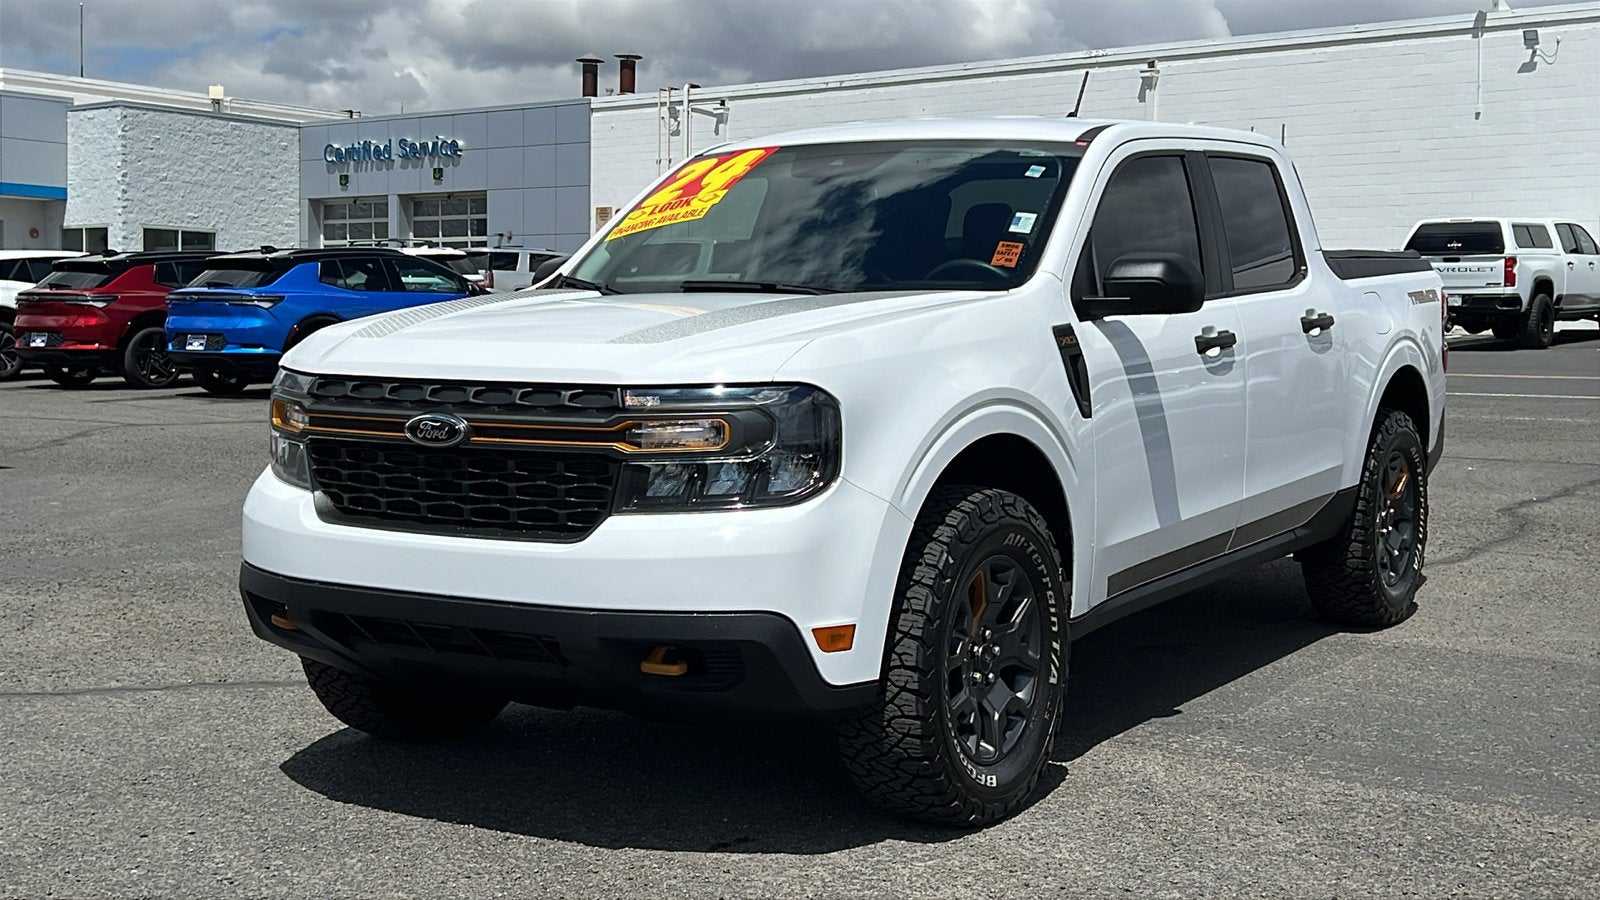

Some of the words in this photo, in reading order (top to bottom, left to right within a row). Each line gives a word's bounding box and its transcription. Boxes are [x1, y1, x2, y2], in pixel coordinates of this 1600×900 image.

[323, 139, 392, 163] Certified
[398, 135, 459, 160] Service
[641, 149, 766, 207] 24
[612, 217, 656, 236] FINANCING
[656, 206, 707, 225] AVAILABLE
[648, 196, 695, 217] LOOK
[416, 420, 449, 440] Ford
[1003, 532, 1060, 633] All-Terrain
[1048, 639, 1061, 685] T/A
